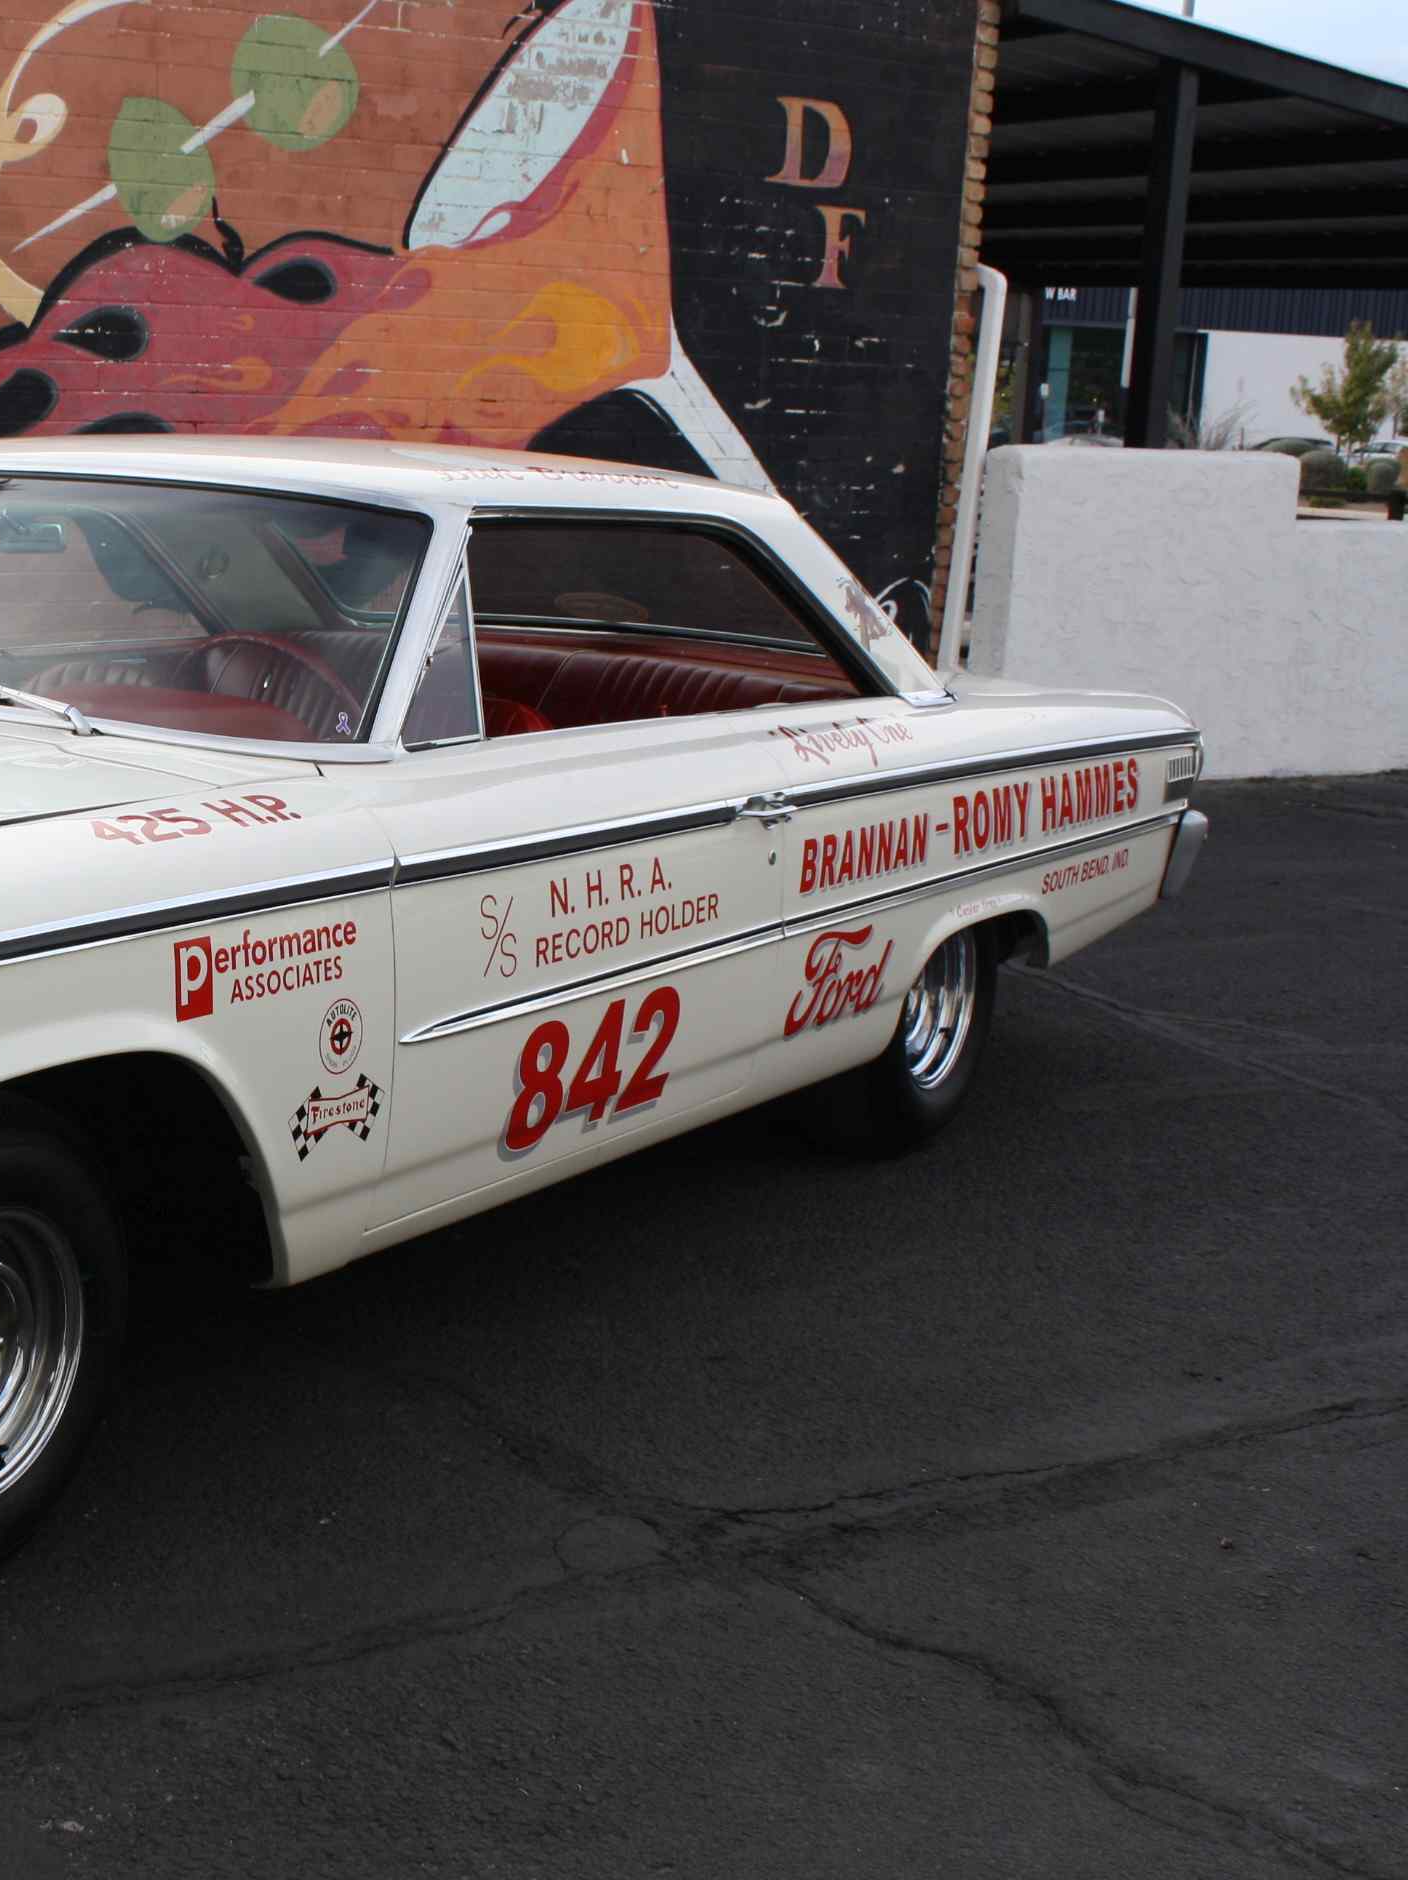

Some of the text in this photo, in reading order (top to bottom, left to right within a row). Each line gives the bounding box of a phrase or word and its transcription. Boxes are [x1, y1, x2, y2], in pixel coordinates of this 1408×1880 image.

[765, 96, 853, 188] D
[812, 205, 866, 289] F
[1057, 287, 1077, 301] BAR
[91, 794, 301, 845] 425 H.P.
[1041, 757, 1138, 833] HAMMES
[1042, 863, 1079, 894] SOUTH
[536, 893, 719, 967] RECORD HOLDER
[230, 956, 343, 1004] ASSOCIATES
[784, 924, 893, 1036] Ford
[326, 1003, 358, 1026] AUTOLITE
[501, 986, 681, 1157] 842
[311, 1099, 365, 1124] Firestone
